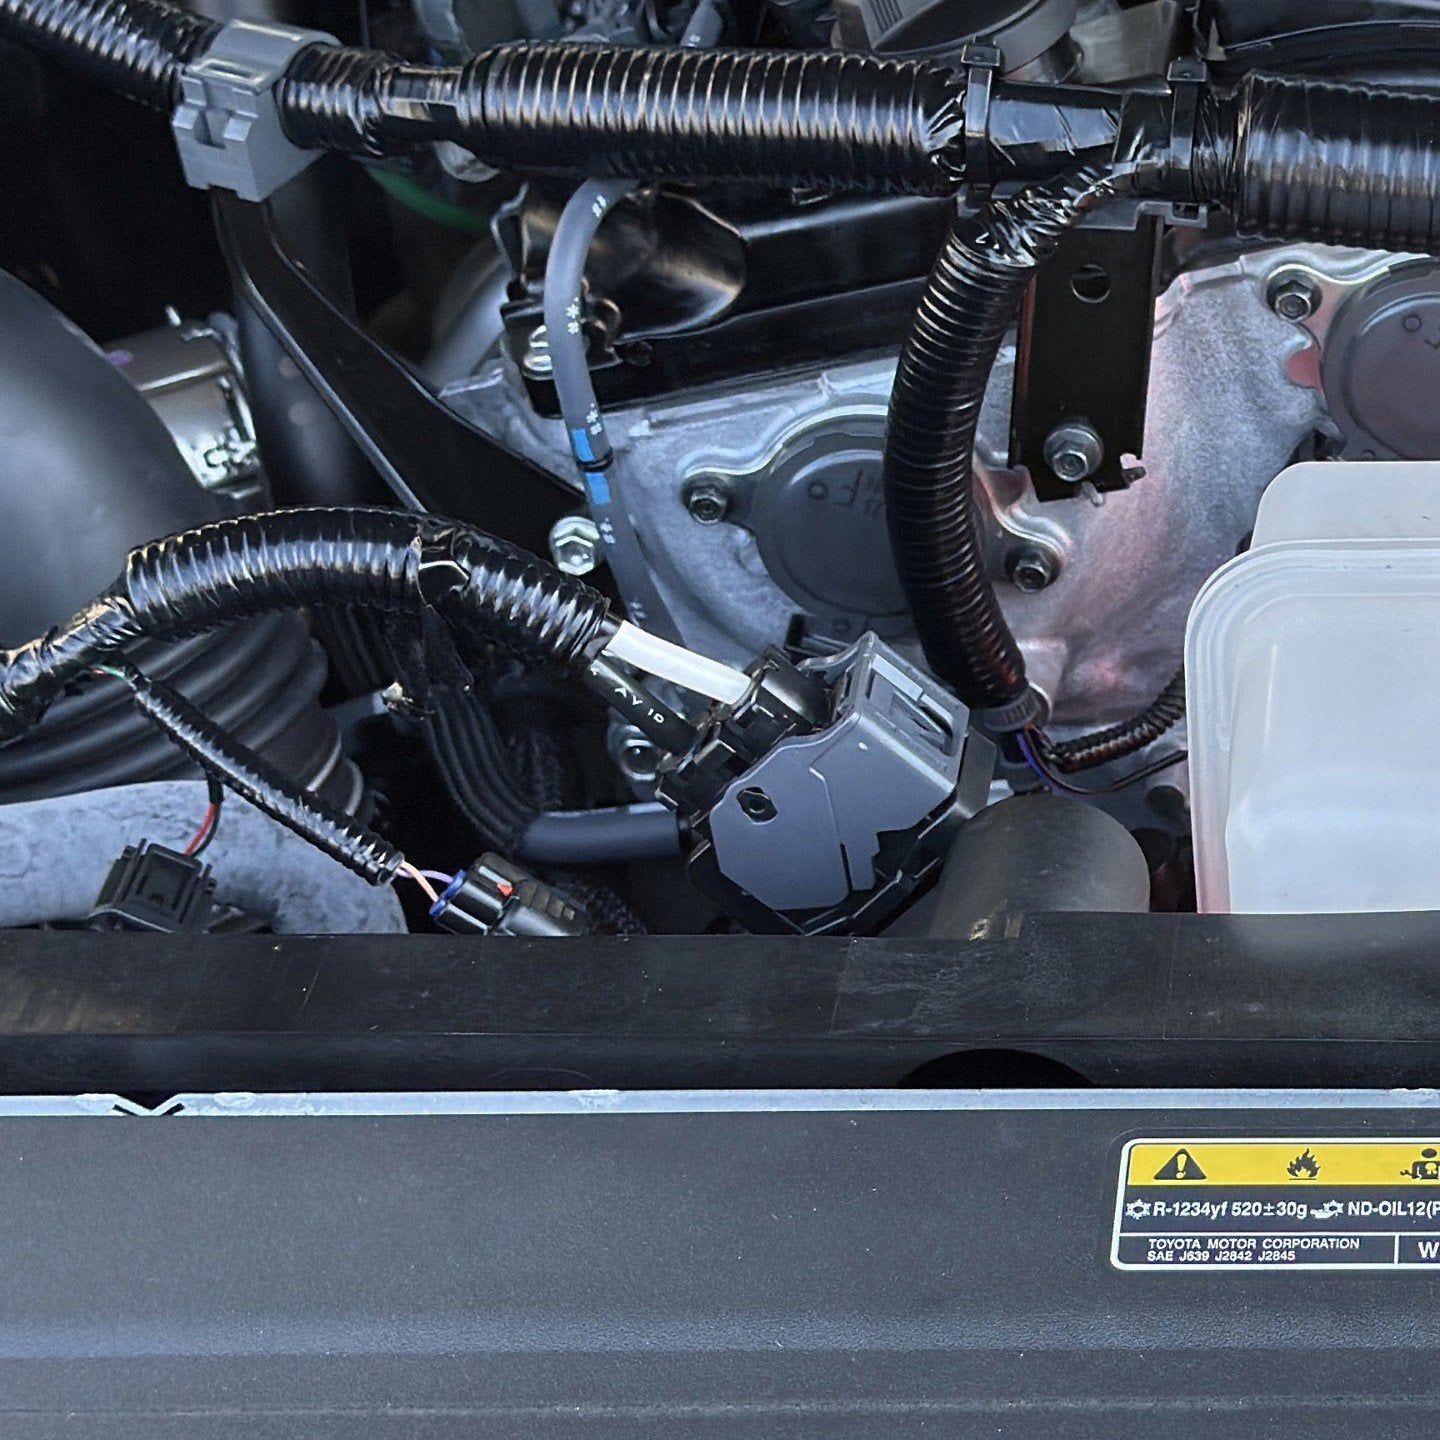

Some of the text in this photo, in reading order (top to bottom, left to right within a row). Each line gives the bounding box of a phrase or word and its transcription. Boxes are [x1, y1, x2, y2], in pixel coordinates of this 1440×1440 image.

[1153, 1201, 1227, 1220] R-1234yf
[1232, 1201, 1308, 1220] 520±30g
[1148, 1237, 1360, 1250] TOYOTA MOTOR CORPORATION
[1146, 1250, 1296, 1262] SAE J639 J2842 J2845
